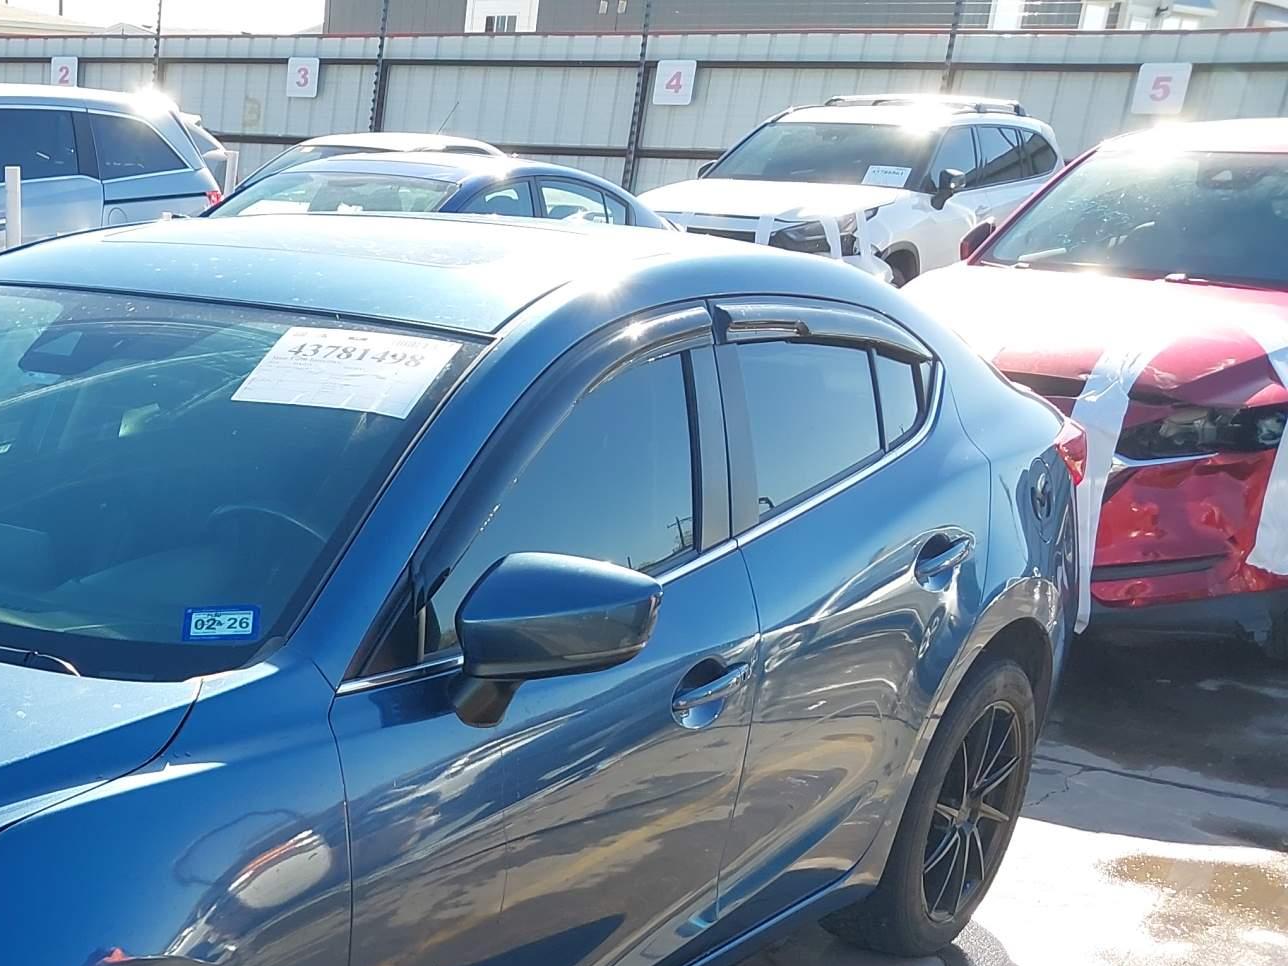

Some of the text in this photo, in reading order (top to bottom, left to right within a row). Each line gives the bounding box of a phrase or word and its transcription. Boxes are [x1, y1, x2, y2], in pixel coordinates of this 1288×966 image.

[58, 66, 70, 84] 2
[296, 67, 309, 87] 3
[665, 71, 682, 93] 4
[1150, 76, 1173, 101] 5
[287, 341, 425, 368] 43781498
[226, 617, 250, 630] 26
